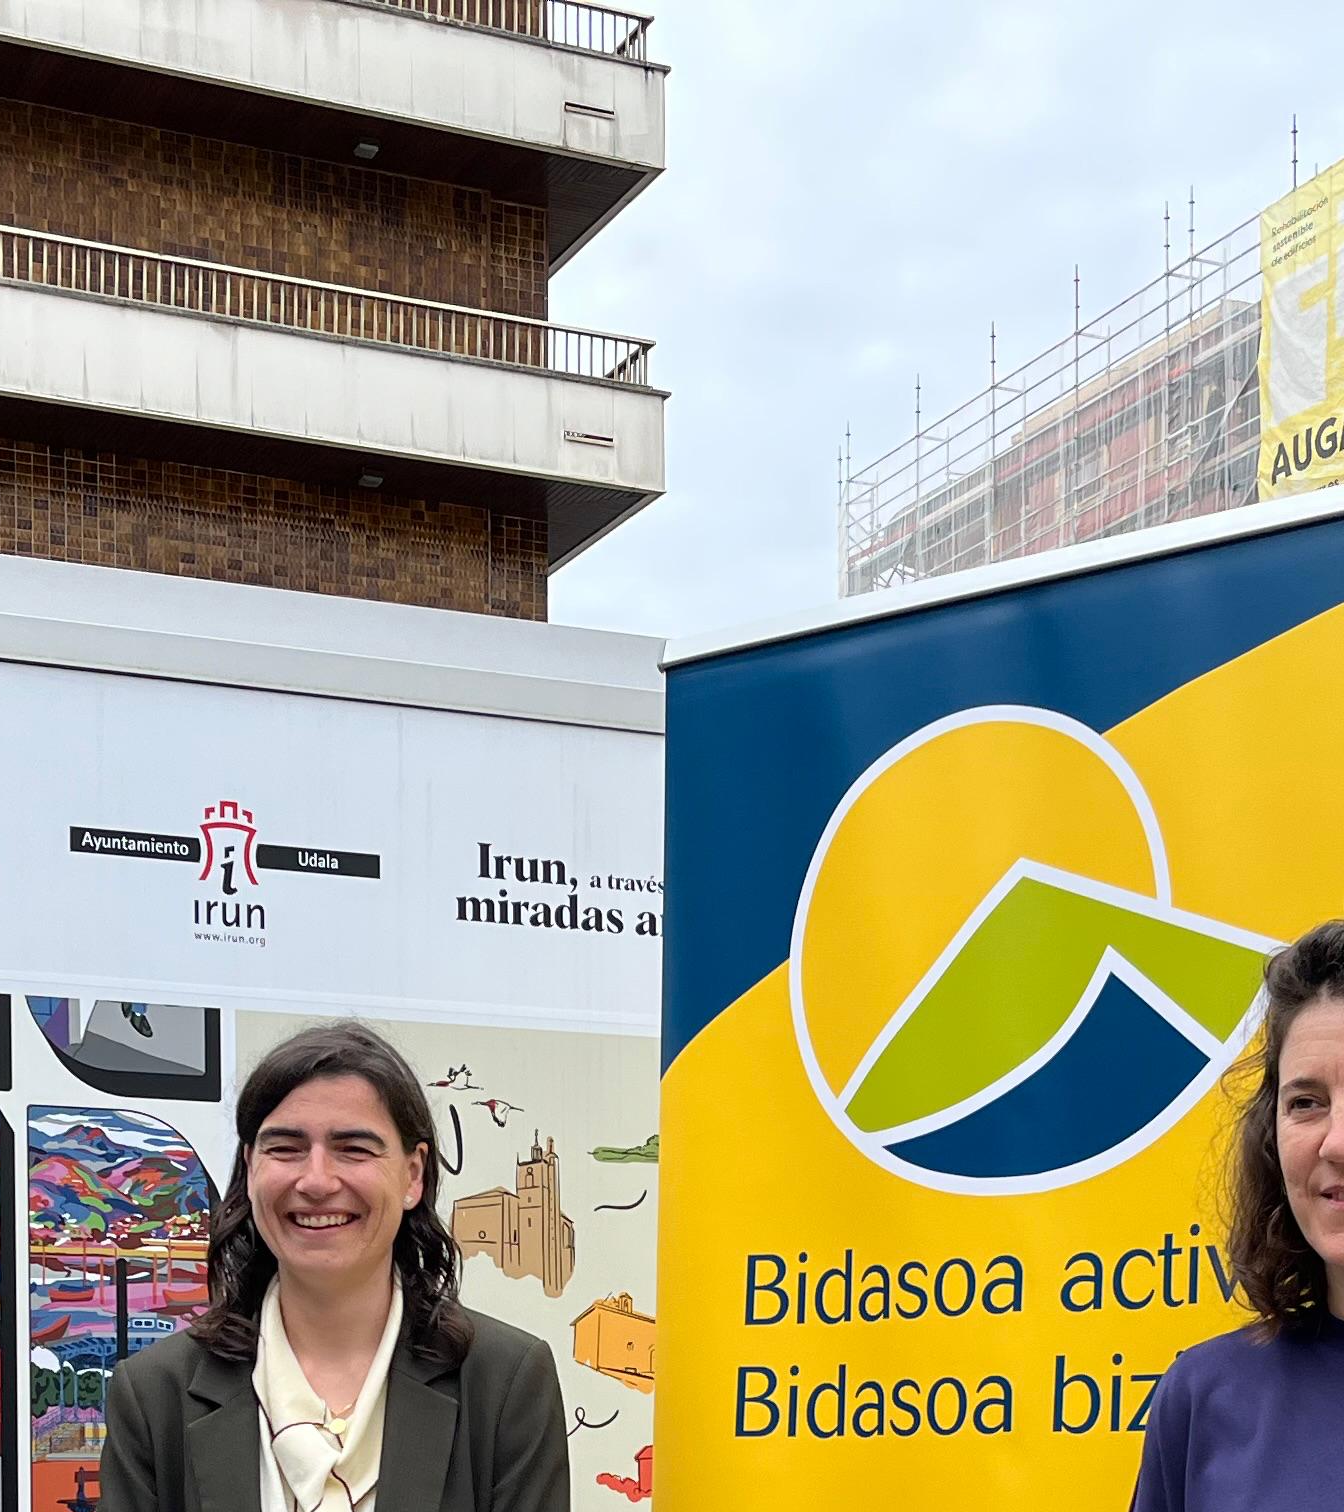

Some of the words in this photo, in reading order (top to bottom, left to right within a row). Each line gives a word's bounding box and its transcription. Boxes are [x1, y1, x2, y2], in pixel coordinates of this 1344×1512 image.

[1271, 256, 1283, 267] de
[1284, 235, 1317, 260] edificios
[1272, 222, 1314, 253] sostenible
[81, 831, 190, 856] Ayuntamiento
[297, 851, 339, 870] Udala
[476, 841, 578, 893] Irun,
[589, 874, 602, 889] a
[193, 899, 265, 929] irun
[455, 888, 625, 934] miradas
[634, 910, 665, 938] a
[193, 931, 266, 947] www.irun.org
[743, 1248, 1024, 1326] Bidasoa
[733, 1363, 1014, 1439] Bidasoa
[1051, 1351, 1184, 1435] biz
